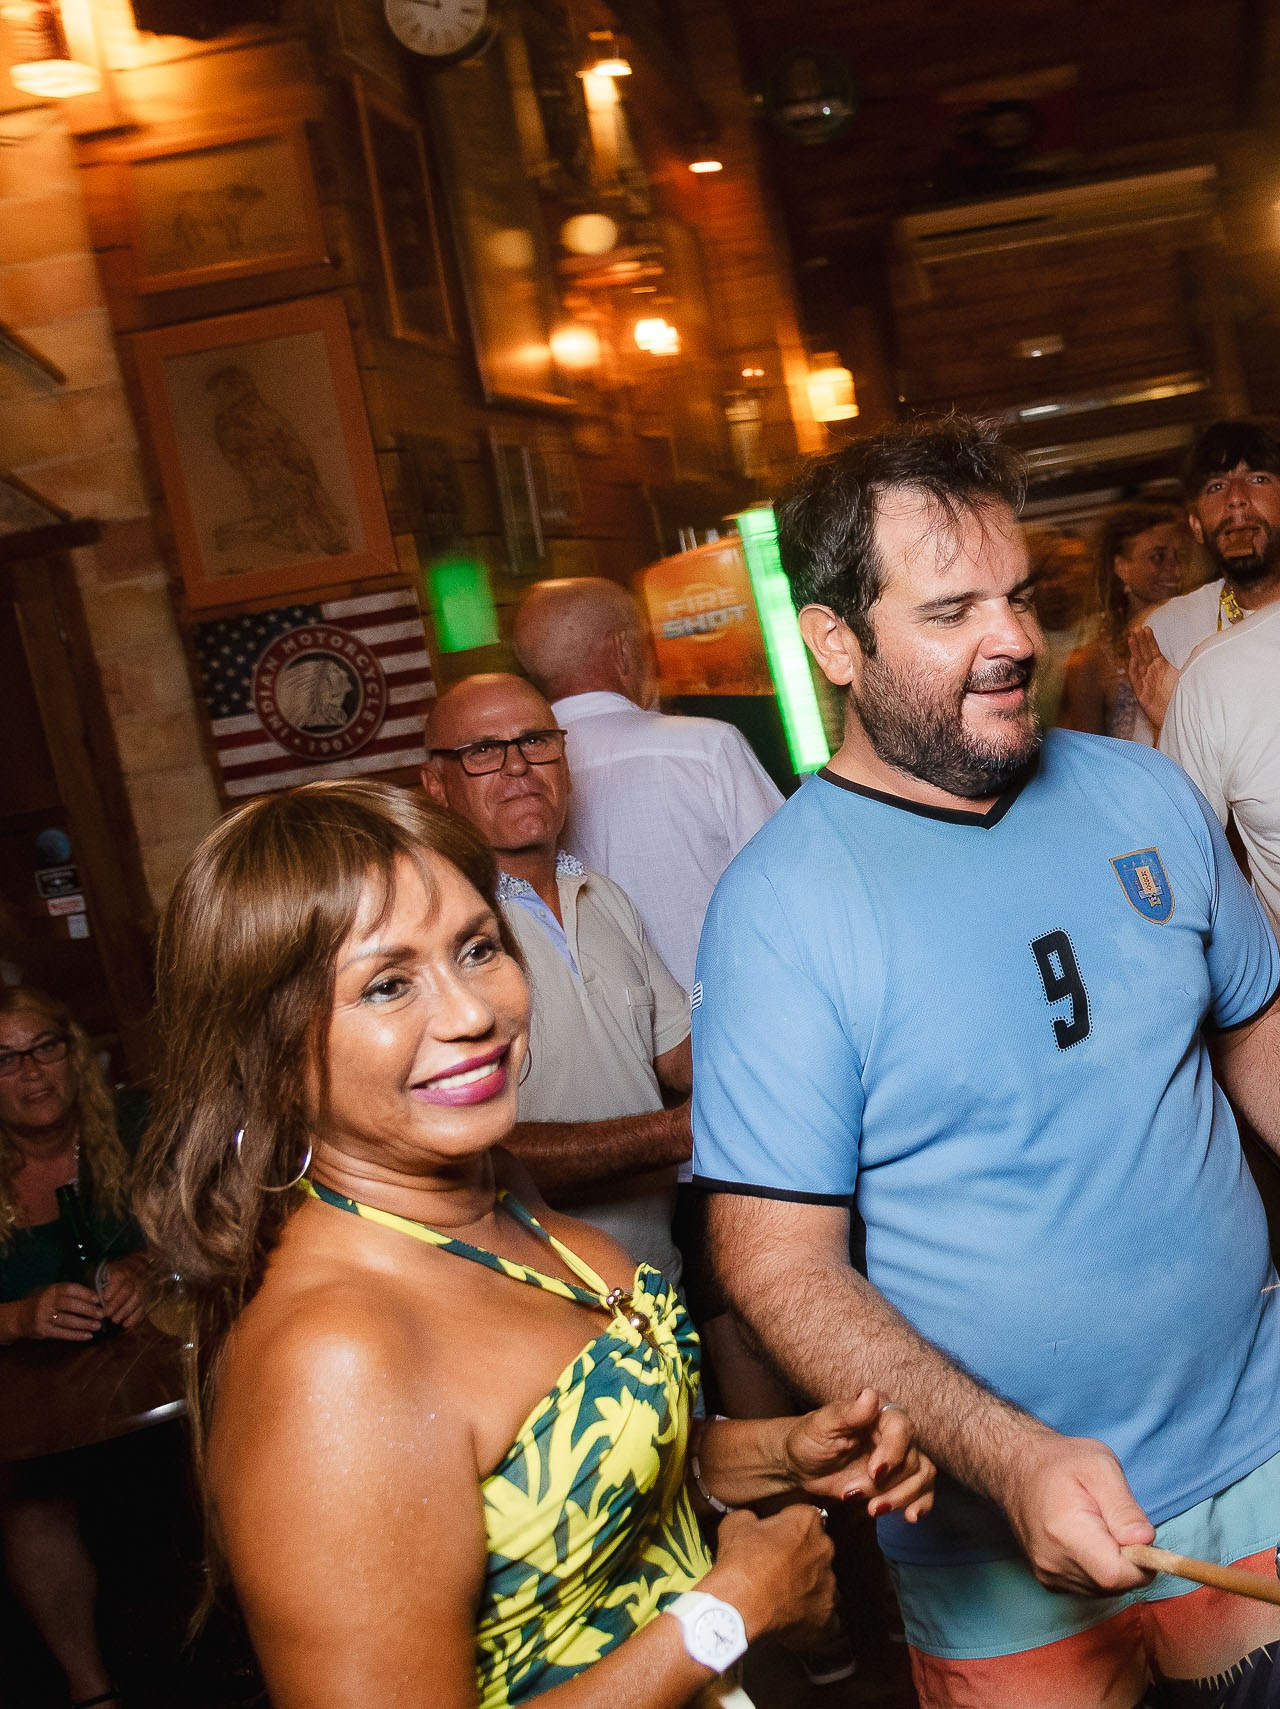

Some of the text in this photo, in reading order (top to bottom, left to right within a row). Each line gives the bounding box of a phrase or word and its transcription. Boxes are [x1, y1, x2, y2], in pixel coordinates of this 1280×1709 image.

[667, 588, 737, 616] FIRE
[662, 604, 748, 640] SHOT
[259, 632, 380, 738] INDIAN MOTORCYCLE
[308, 734, 354, 753] 1901
[1028, 927, 1093, 1052] 9
